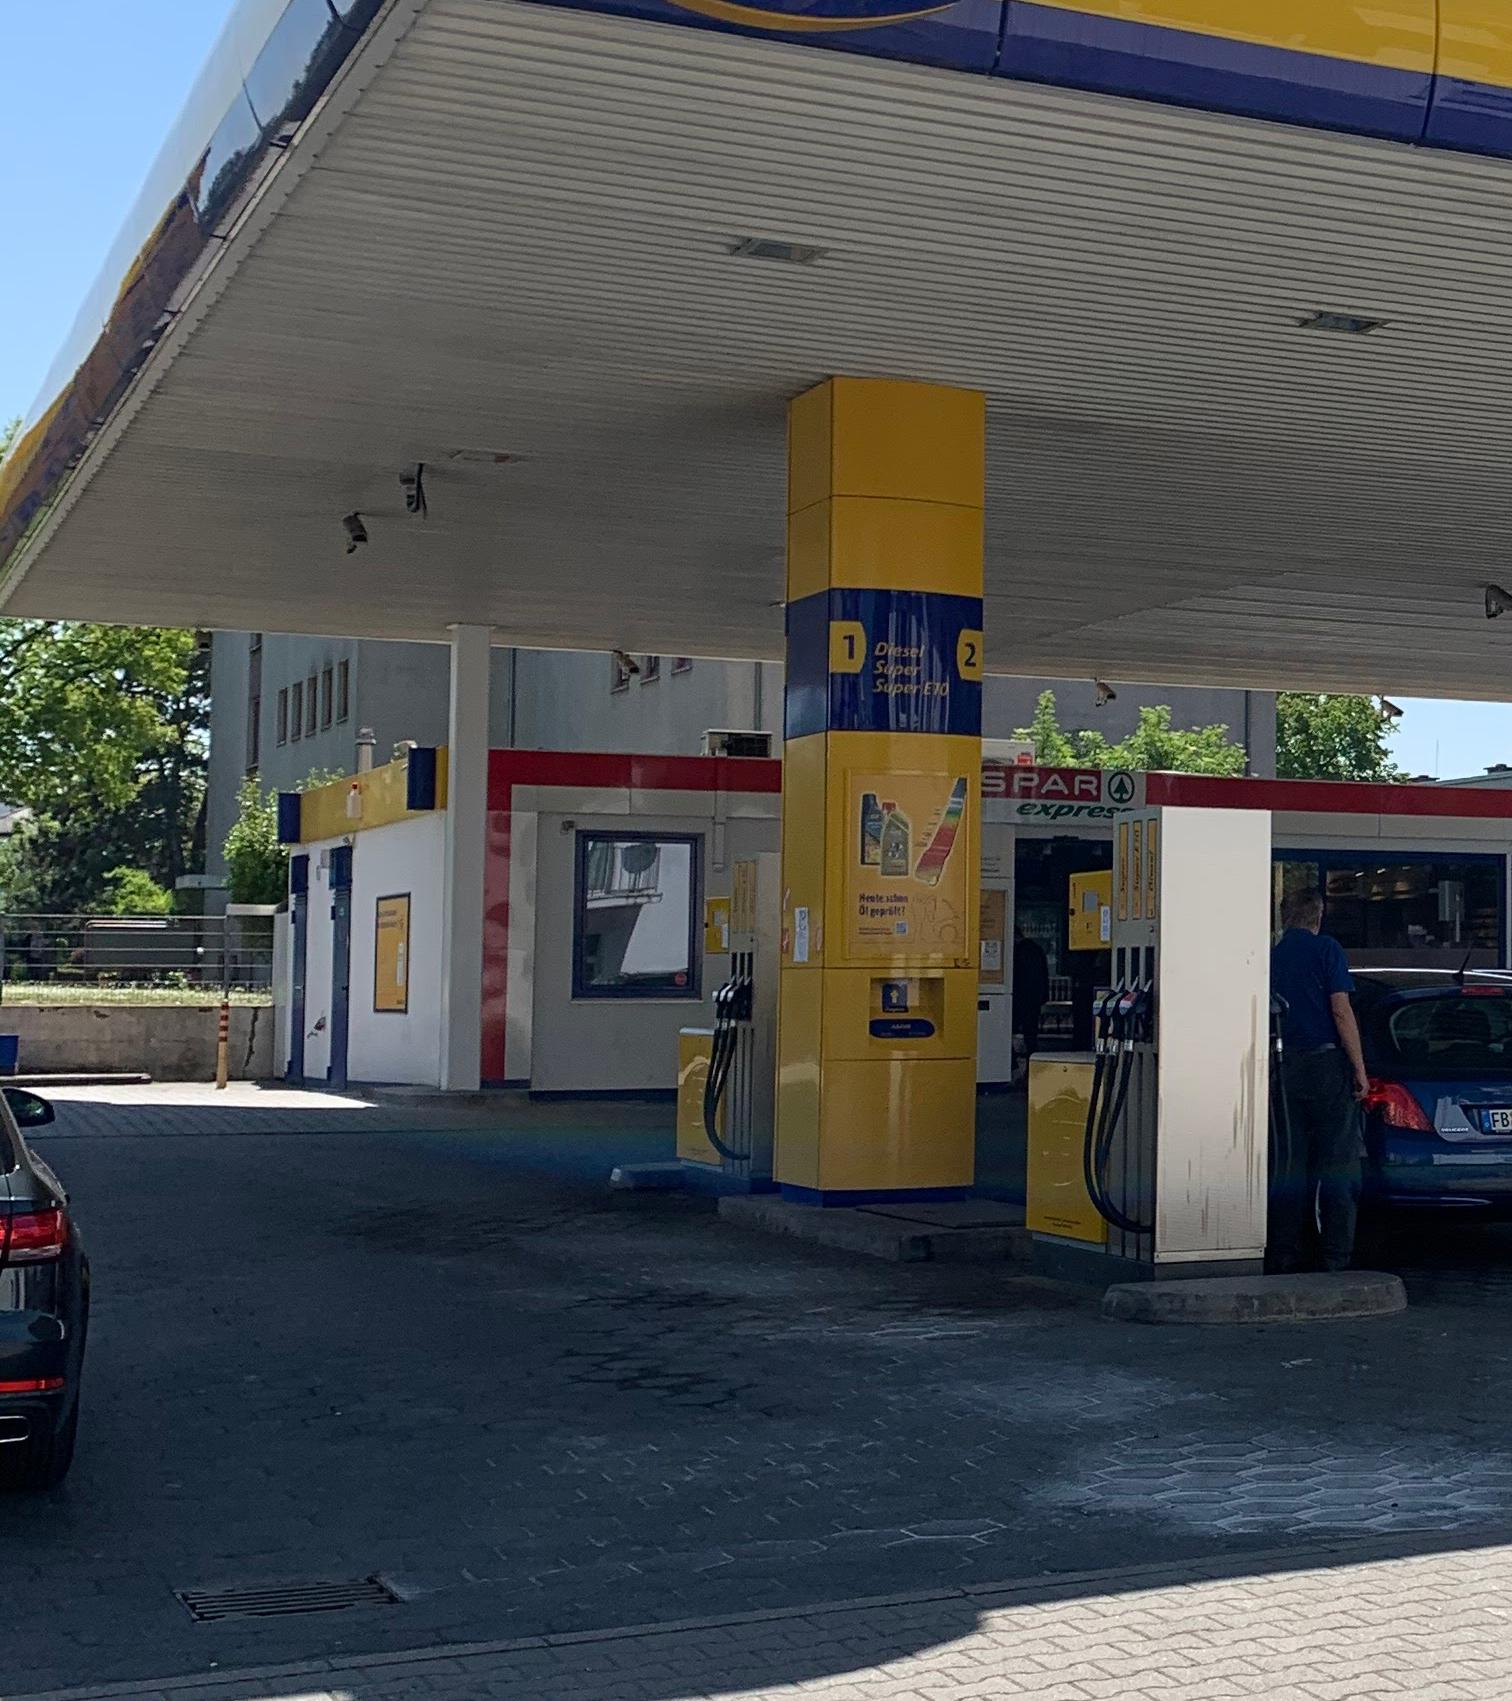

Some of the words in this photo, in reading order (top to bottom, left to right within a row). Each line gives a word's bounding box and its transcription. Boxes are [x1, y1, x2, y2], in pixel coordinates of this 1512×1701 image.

[843, 635, 855, 660] 1
[874, 642, 926, 657] Diesel
[964, 642, 977, 667] 2
[873, 660, 922, 677] Super
[873, 679, 922, 697] Super
[923, 682, 950, 697] E10
[982, 771, 1098, 797] SPAR
[1491, 1111, 1510, 1128] FB
